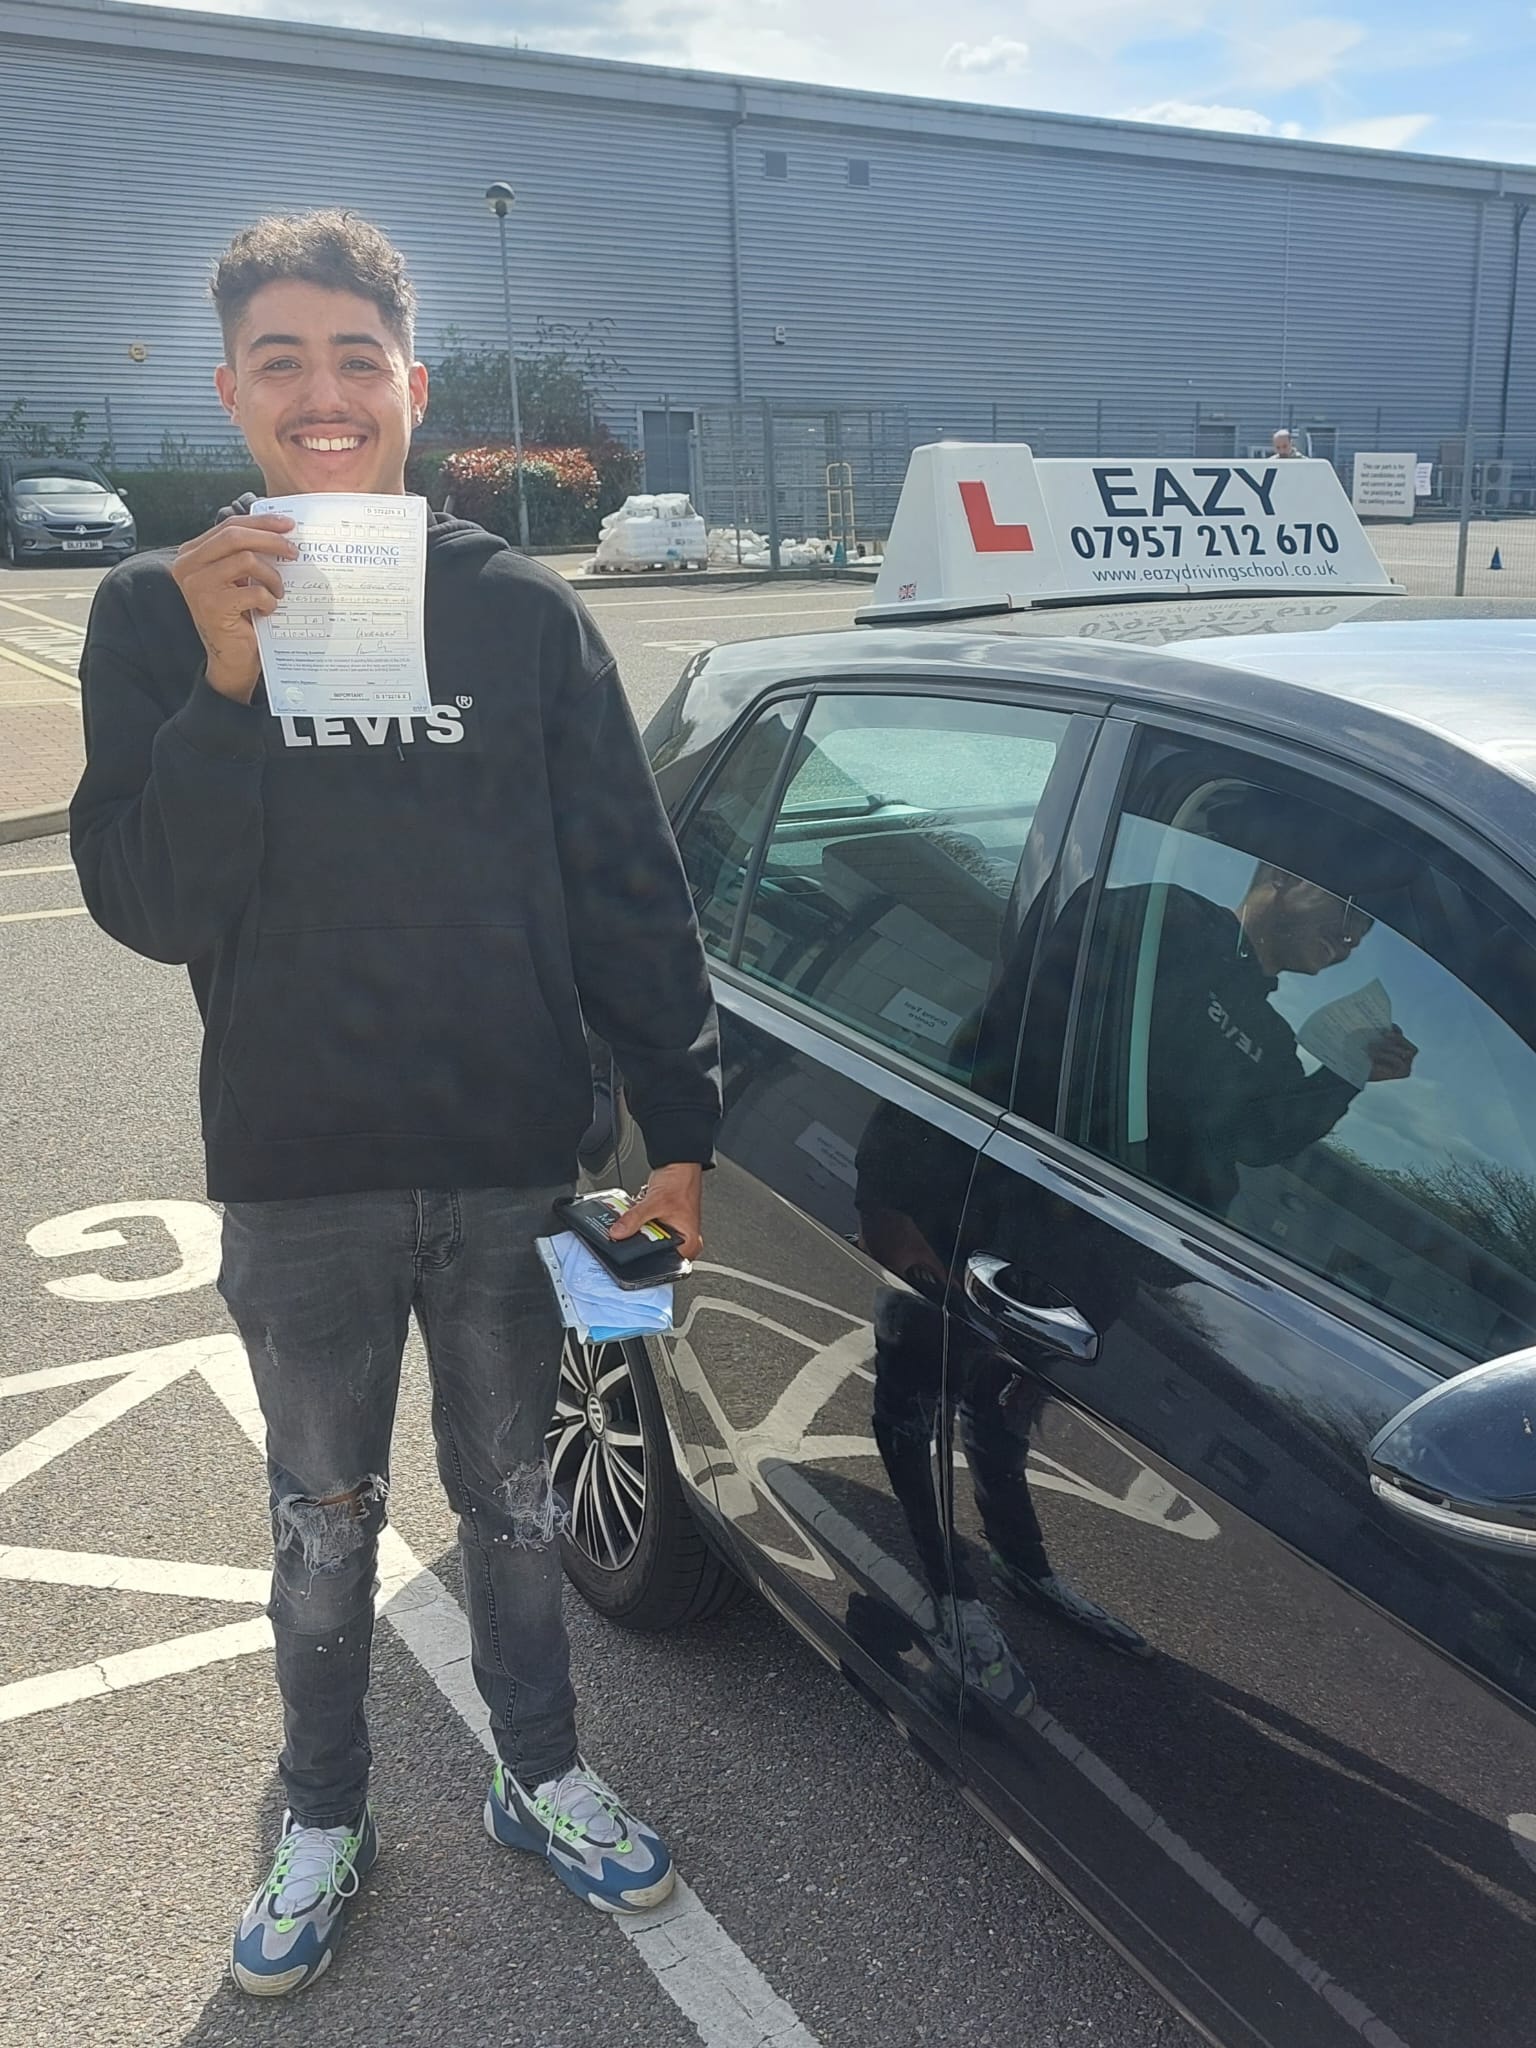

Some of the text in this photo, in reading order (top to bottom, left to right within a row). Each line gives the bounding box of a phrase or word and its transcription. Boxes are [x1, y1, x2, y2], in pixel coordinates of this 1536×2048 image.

[1092, 467, 1279, 518] EAZY
[957, 481, 1035, 553] L
[297, 542, 400, 556] CTICAL DRIVING
[1070, 521, 1340, 560] 07957 212 670
[303, 553, 329, 562] PASS
[332, 554, 399, 566] CERTIFICATE
[1092, 560, 1339, 583] www.eazydrivingschool.co.uk
